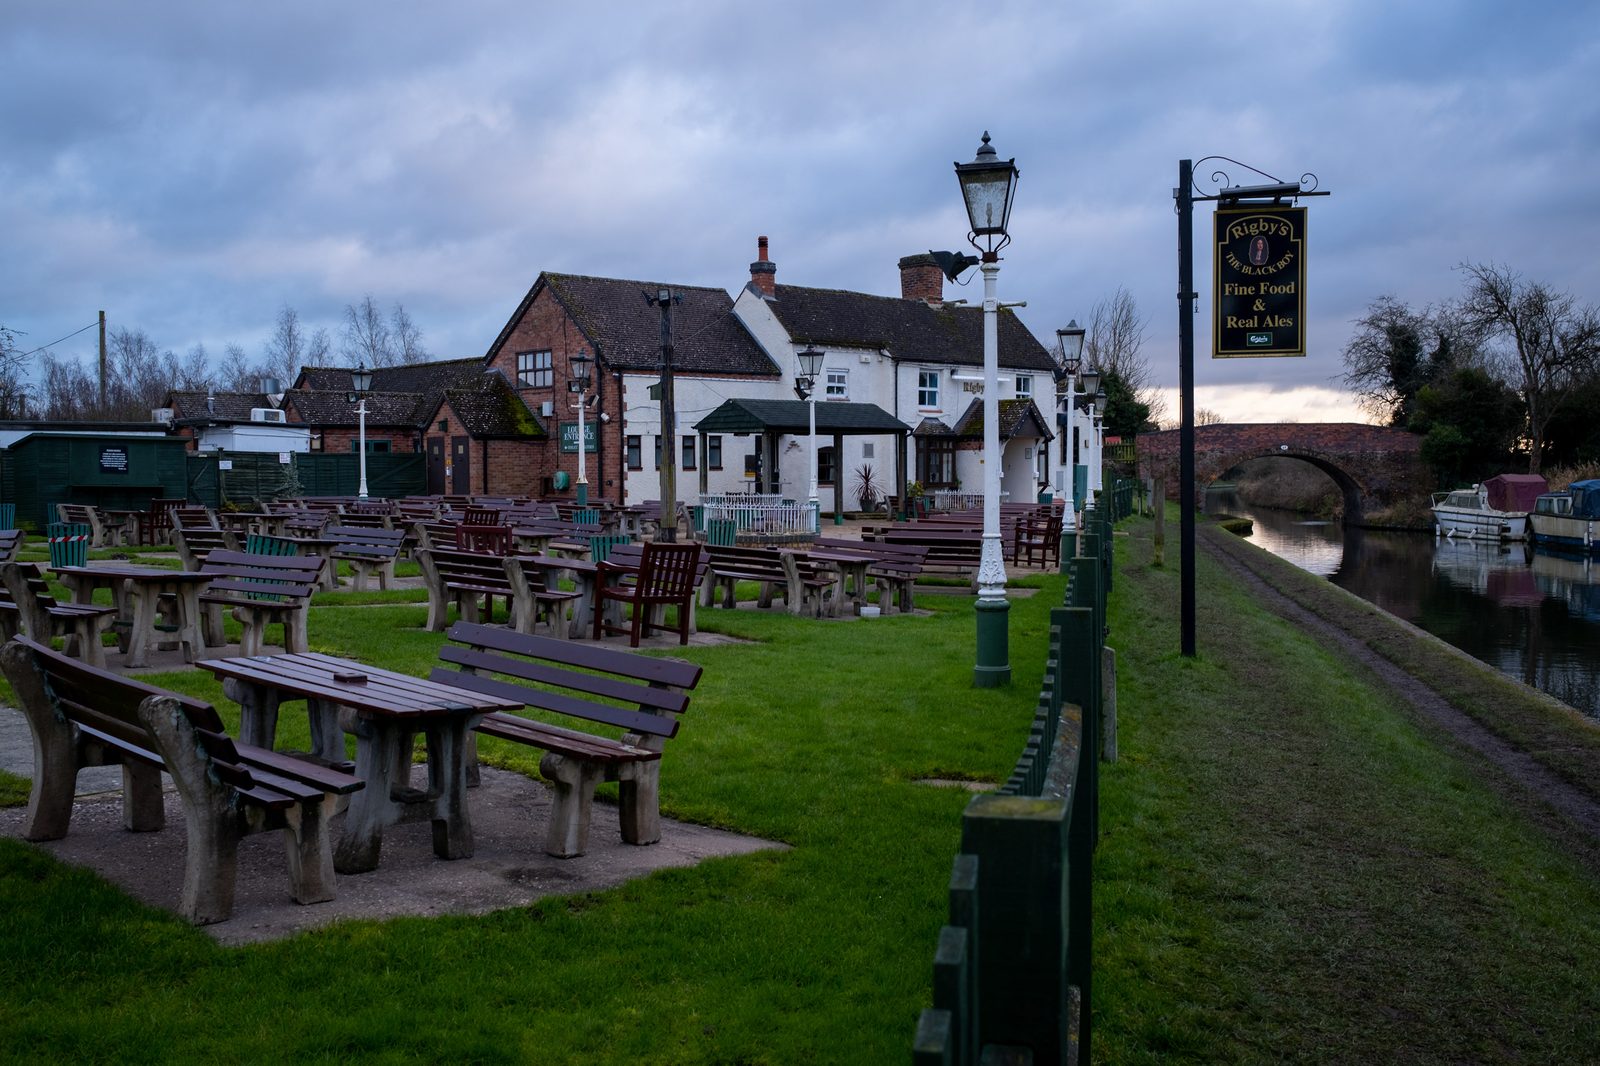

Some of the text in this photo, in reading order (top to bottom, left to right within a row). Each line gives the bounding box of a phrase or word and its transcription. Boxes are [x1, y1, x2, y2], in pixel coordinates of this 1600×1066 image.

[1232, 219, 1289, 239] Rigby's
[1226, 250, 1294, 276] THE BLACK BOY
[1224, 281, 1295, 296] Fine Food
[1252, 298, 1266, 312] &
[1226, 314, 1293, 329] Real Ales
[963, 382, 985, 395] Rigby
[564, 432, 594, 440] ENTRNCE
[567, 425, 591, 433] LOUGE
